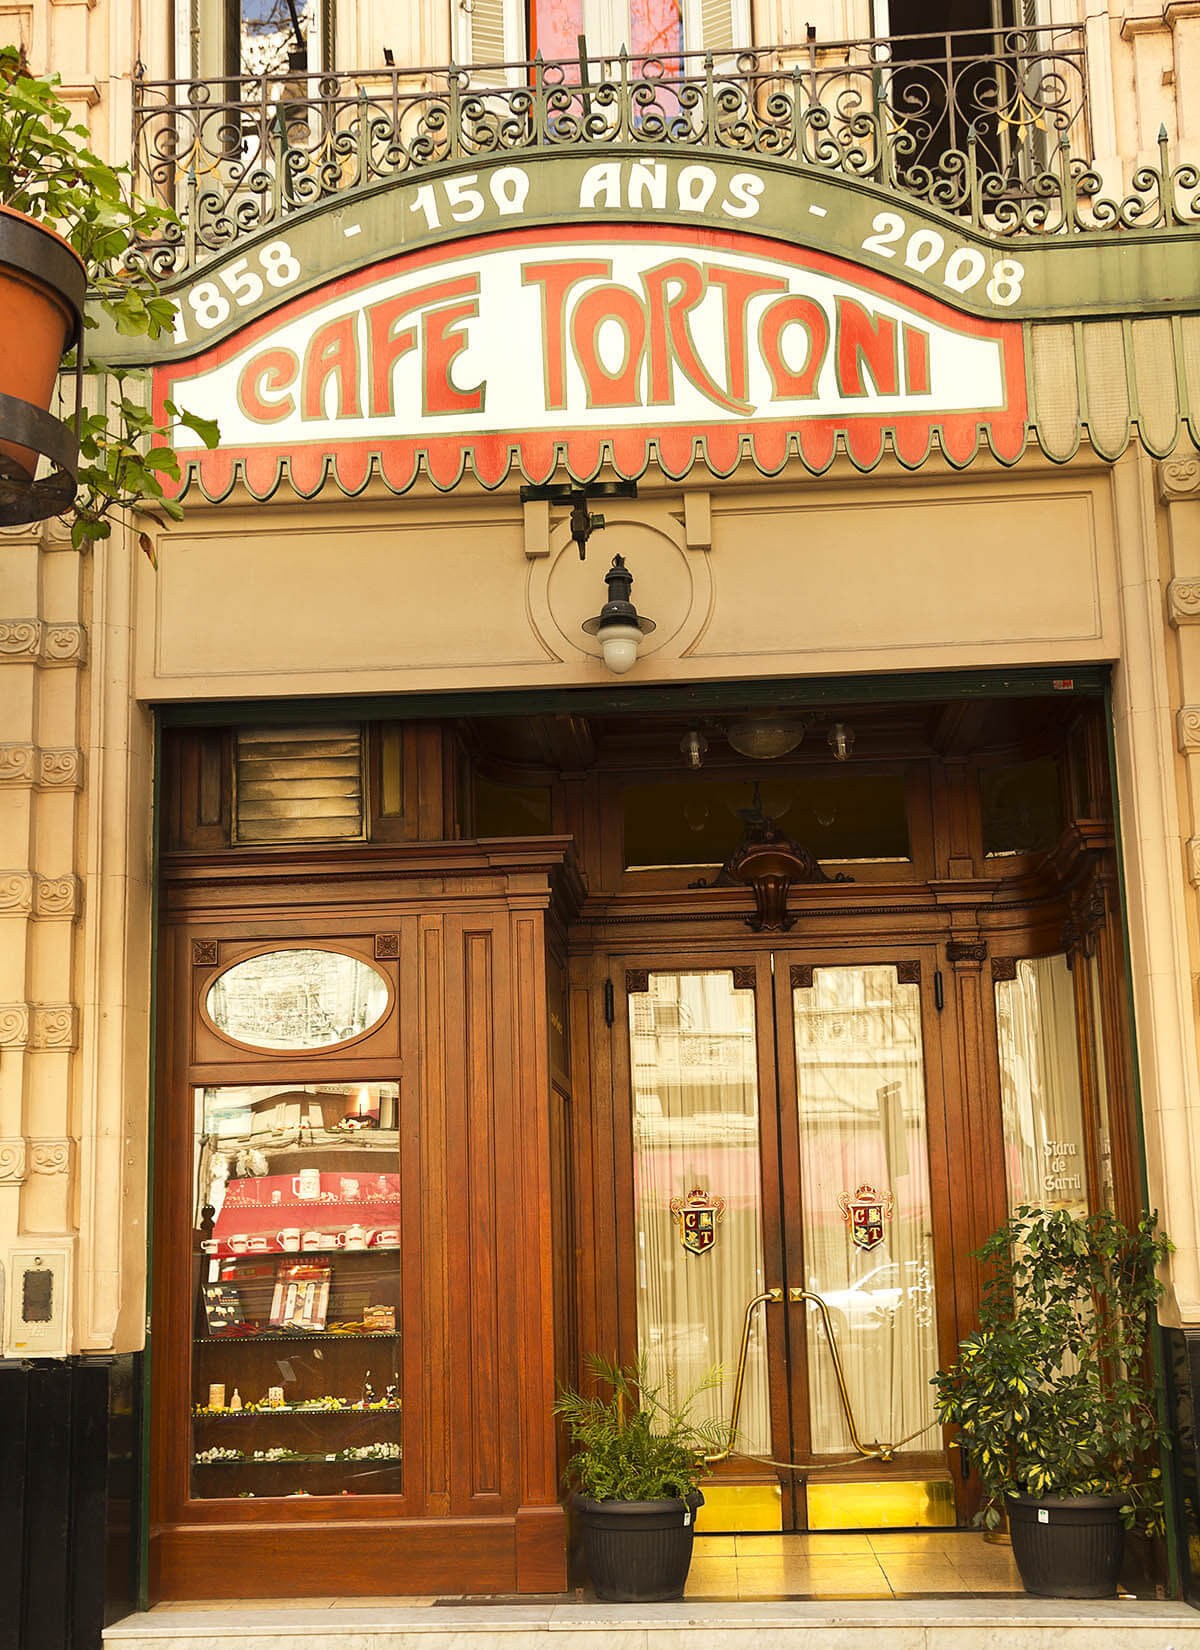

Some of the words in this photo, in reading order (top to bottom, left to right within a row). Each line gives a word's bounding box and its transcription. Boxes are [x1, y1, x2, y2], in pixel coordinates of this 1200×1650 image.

[170, 240, 302, 345] 1858
[409, 166, 531, 229] 150
[578, 158, 766, 219] AÑOS
[861, 212, 1026, 307] 2008
[236, 271, 487, 425] CAFE
[520, 256, 932, 417] TORTONI
[1051, 1157, 1066, 1173] de
